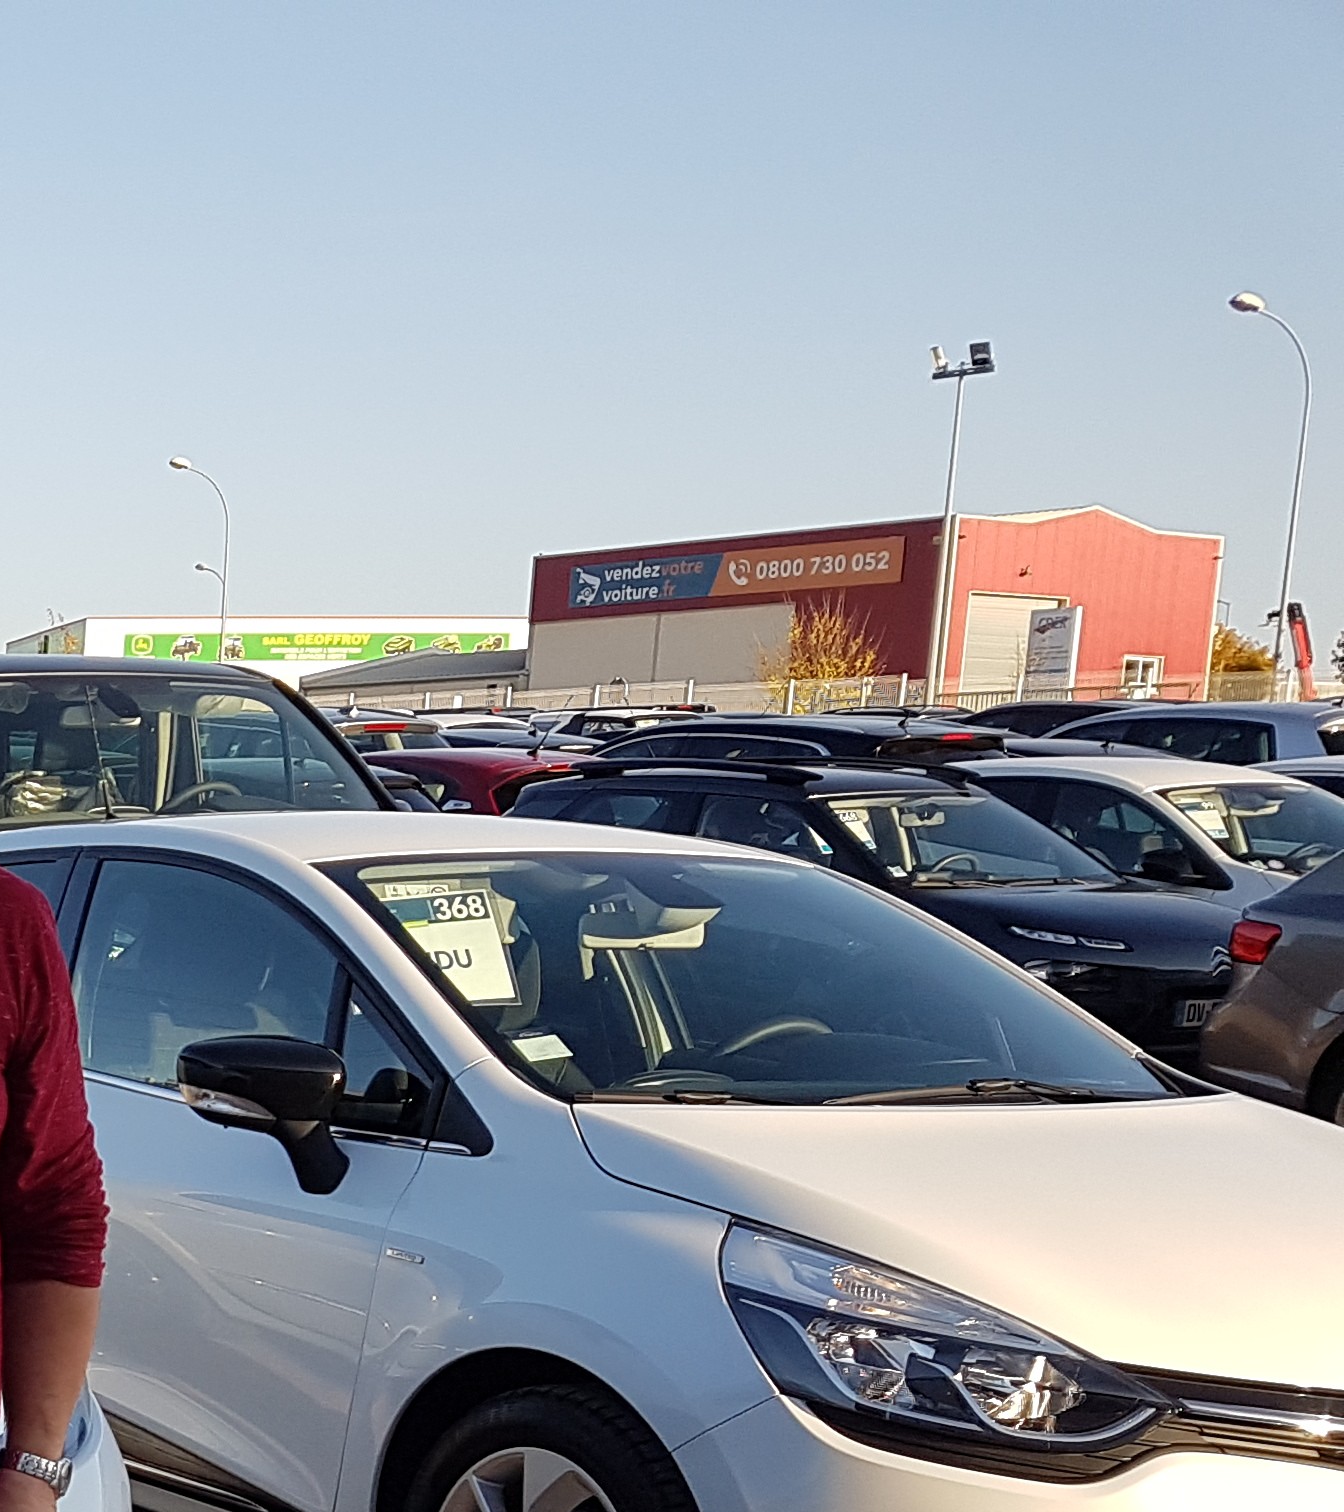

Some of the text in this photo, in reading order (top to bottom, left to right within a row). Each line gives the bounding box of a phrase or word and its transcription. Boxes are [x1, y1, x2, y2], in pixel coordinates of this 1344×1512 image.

[755, 558, 804, 581] 0800
[810, 554, 846, 576] 730
[851, 551, 890, 572] 052
[262, 634, 371, 645] SARL GEOFFROY
[432, 895, 486, 920] 368
